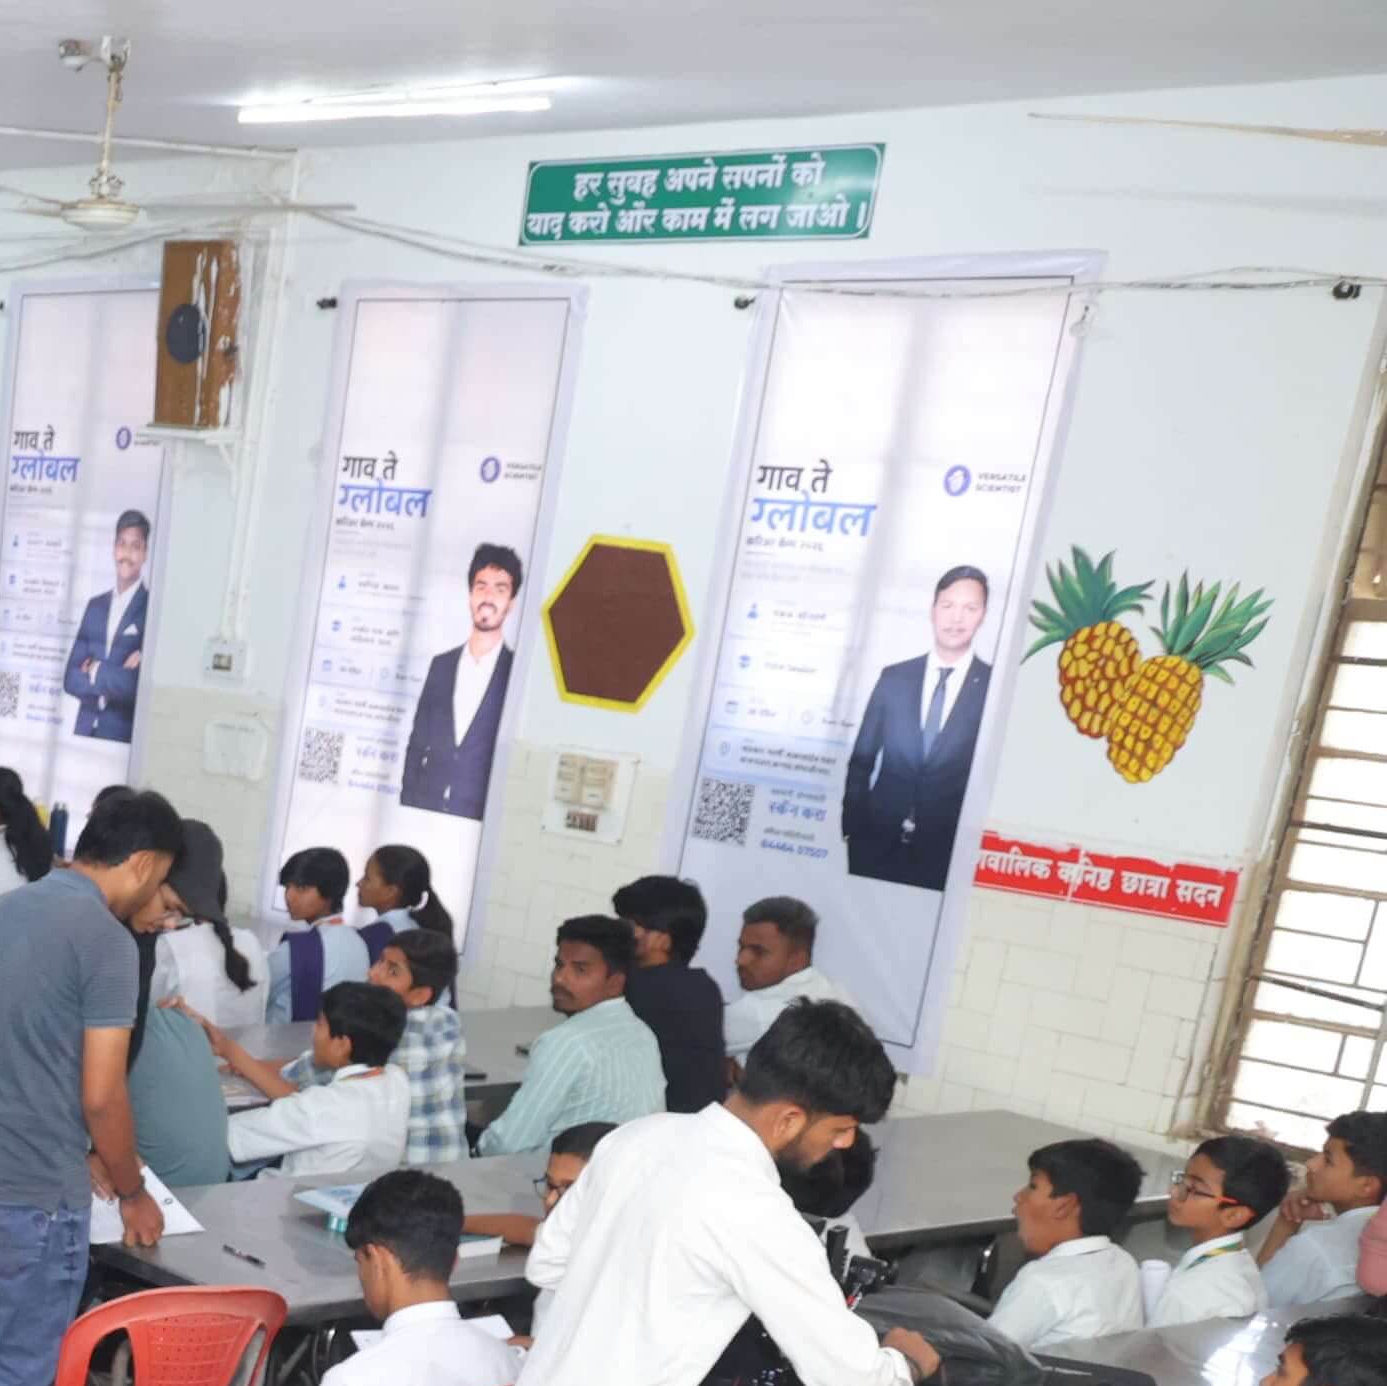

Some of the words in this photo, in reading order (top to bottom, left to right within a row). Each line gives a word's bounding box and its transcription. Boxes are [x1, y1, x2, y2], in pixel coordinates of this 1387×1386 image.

[573, 171, 602, 200] हर
[607, 168, 661, 206] सुबह
[664, 157, 718, 193] अपने
[722, 152, 785, 190] सपनों
[791, 152, 827, 187] को
[527, 211, 566, 240] याद
[569, 202, 610, 235] करो
[615, 200, 660, 236] और
[662, 204, 710, 232] काम
[714, 197, 736, 230] में
[739, 203, 782, 230] लग
[13, 430, 39, 450] गाव
[43, 424, 56, 451] ते
[11, 450, 81, 482] ग्लोबल
[341, 454, 378, 480] गाव
[382, 450, 399, 481] ते
[756, 464, 805, 493] गाव
[811, 458, 834, 494] ते
[337, 476, 433, 518] ग्लोबल
[750, 489, 878, 537] ग्लोबल
[1120, 869, 1170, 899] छात्रा
[1175, 878, 1225, 909] सदन
